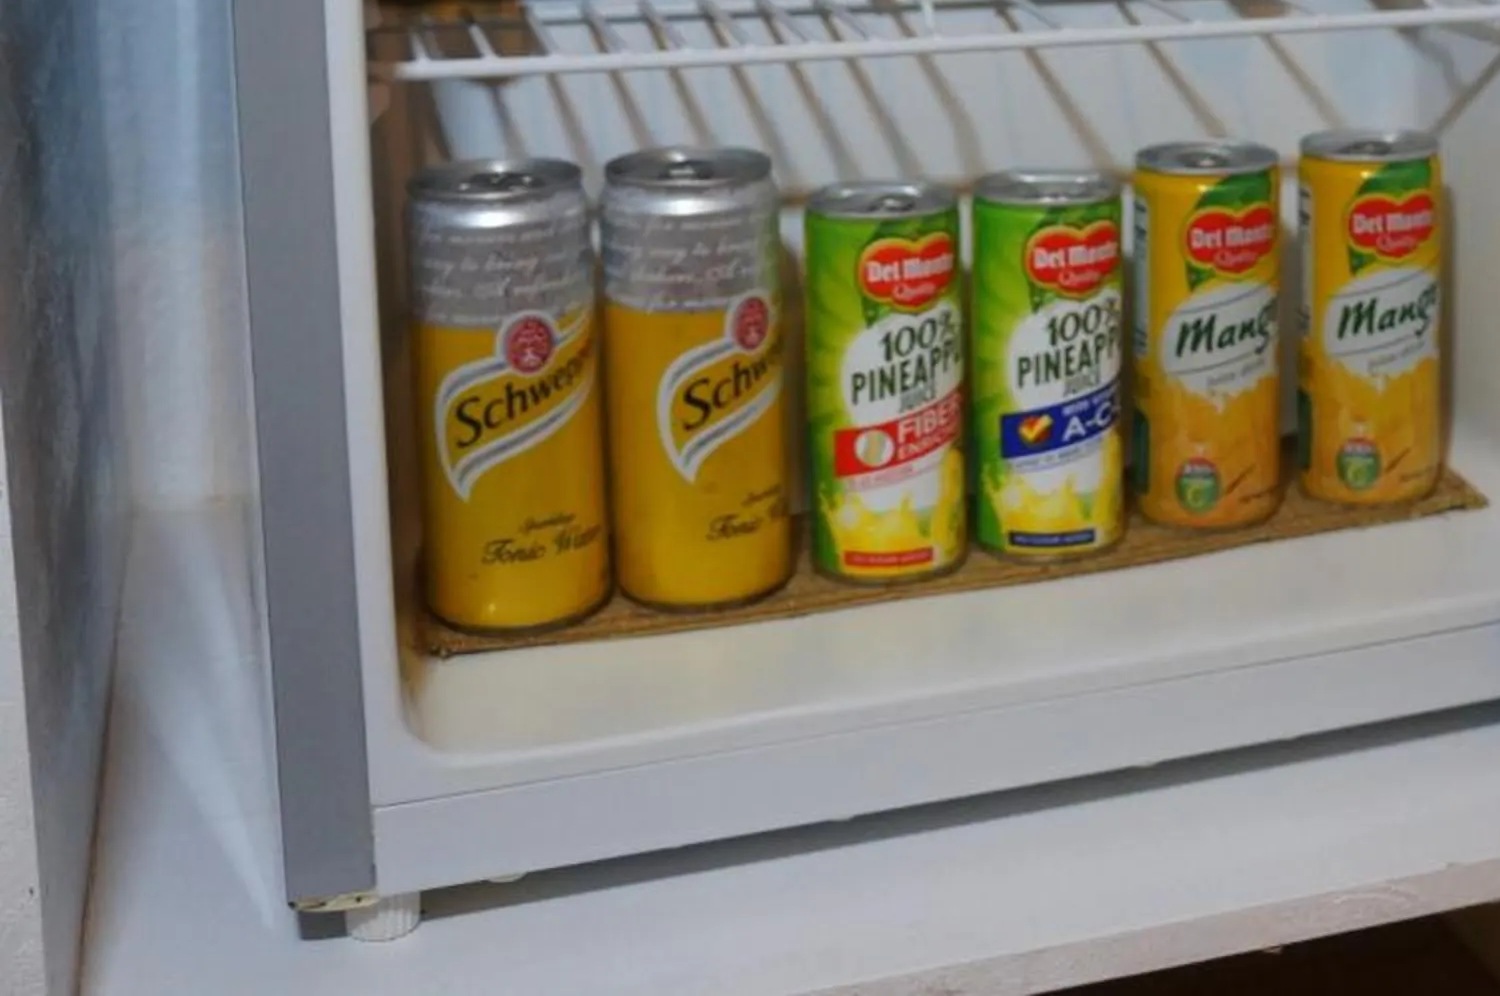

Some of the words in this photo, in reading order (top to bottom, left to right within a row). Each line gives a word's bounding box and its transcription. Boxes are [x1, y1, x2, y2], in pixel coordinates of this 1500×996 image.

[1353, 213, 1383, 234] Del
[1190, 228, 1222, 249] Del
[1033, 247, 1065, 269] Del
[866, 260, 900, 283] Del
[1048, 297, 1120, 346] 100%
[880, 309, 957, 361] 100%
